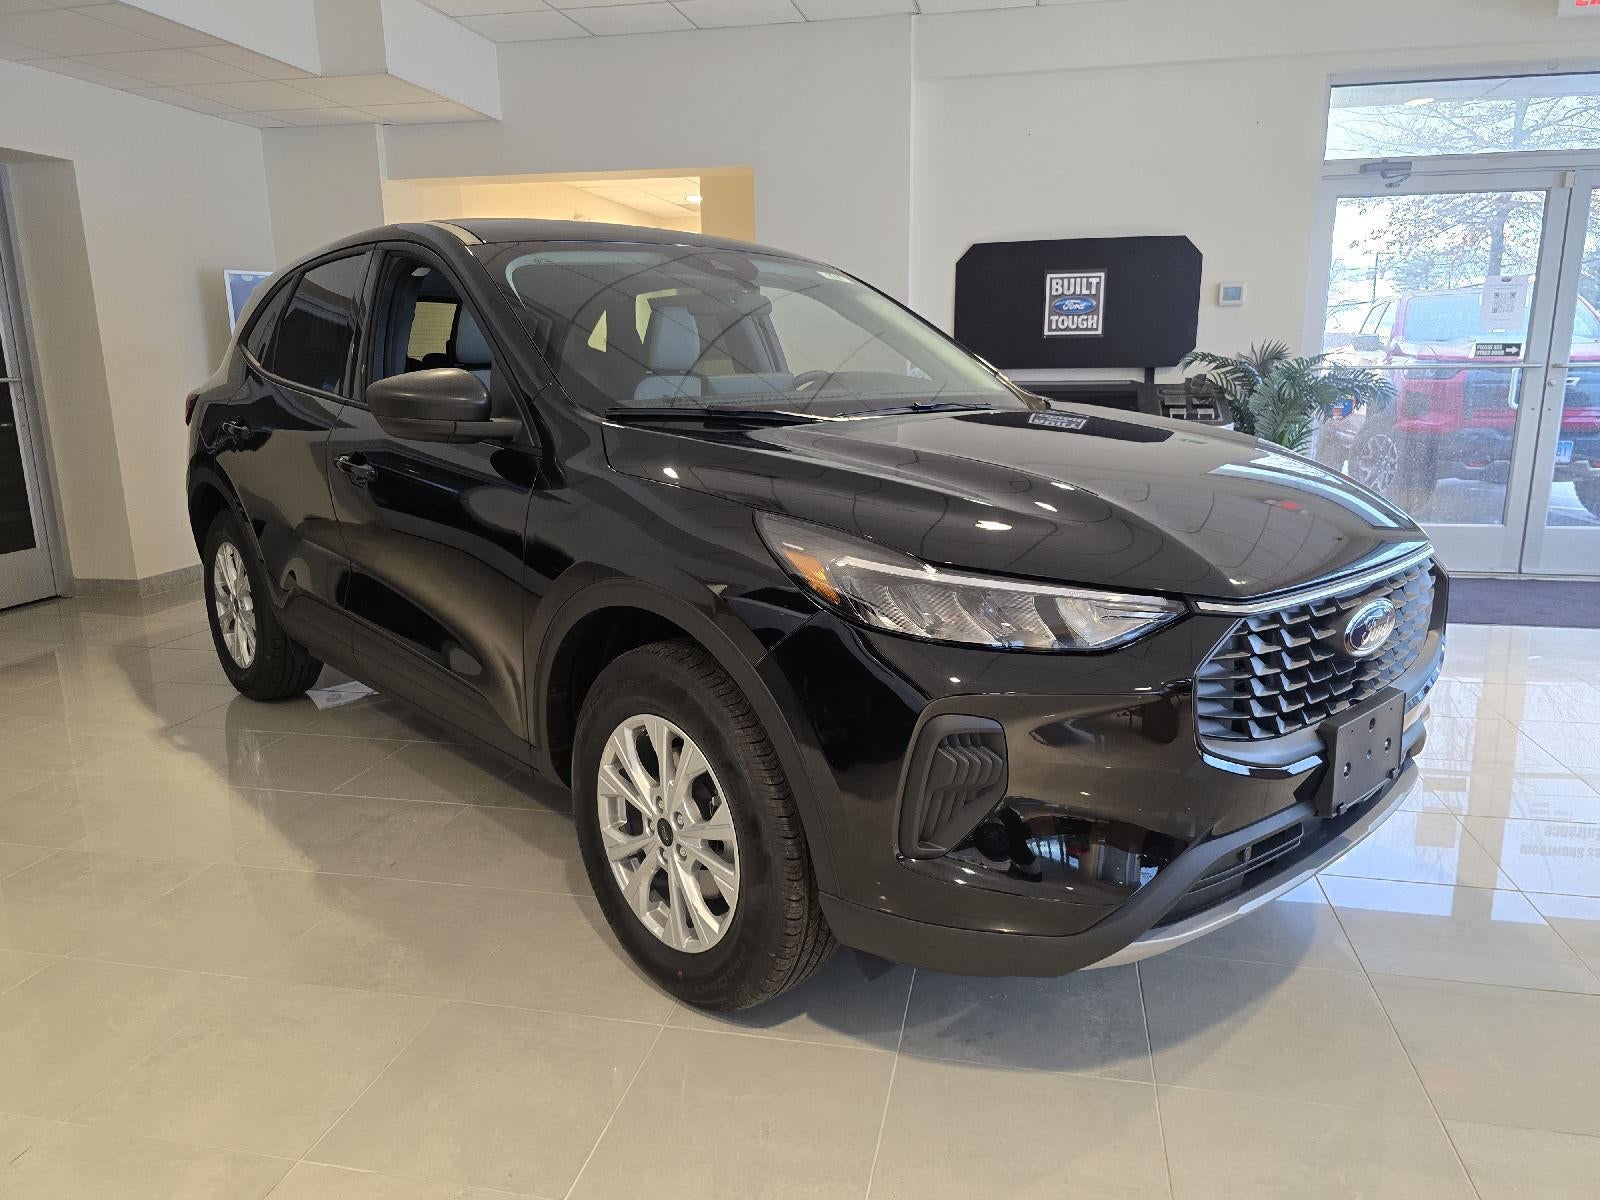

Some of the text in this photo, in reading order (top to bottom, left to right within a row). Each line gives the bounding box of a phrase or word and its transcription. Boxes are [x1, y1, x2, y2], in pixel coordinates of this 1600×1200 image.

[1051, 277, 1100, 295] BUILT
[1062, 299, 1086, 310] Ford
[1049, 314, 1098, 330] TOUGH
